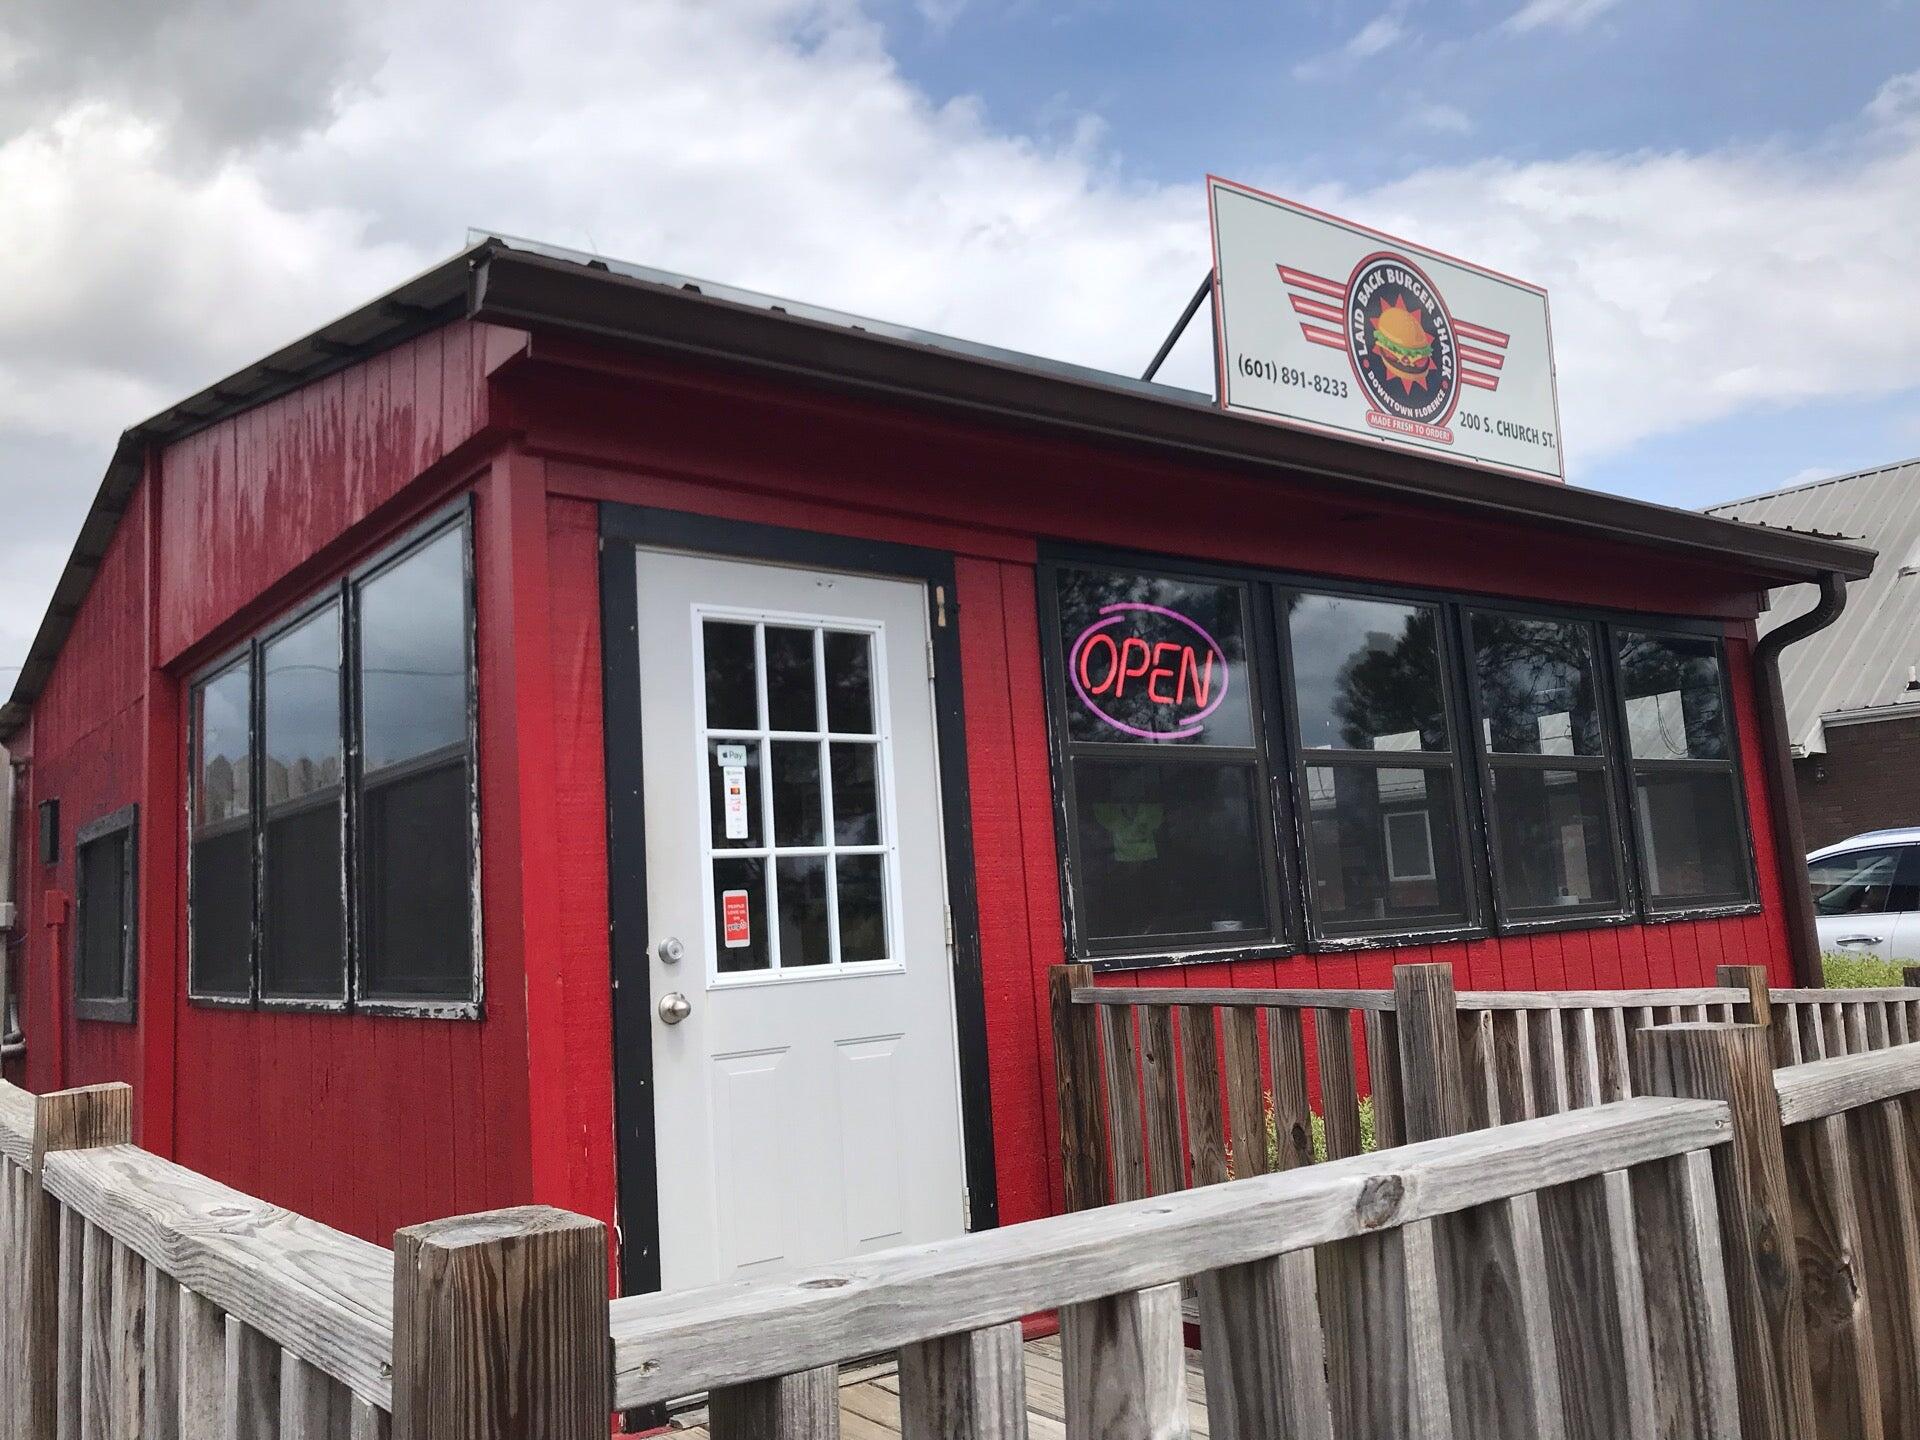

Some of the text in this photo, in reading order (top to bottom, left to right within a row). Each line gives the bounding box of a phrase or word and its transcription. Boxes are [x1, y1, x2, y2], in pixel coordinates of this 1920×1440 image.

[1354, 268, 1452, 380] LAID BACK BURGER SHACK
[1238, 353, 1348, 398] (601) 891-8233
[1368, 370, 1446, 418] DOWNTOWN FLORENCE
[1371, 414, 1450, 440] MADE FRESH TO ORDER!
[1460, 411, 1555, 449] 200 S. CHURCH ST.
[1080, 633, 1213, 708] OPEN
[729, 750, 743, 760] Pay
